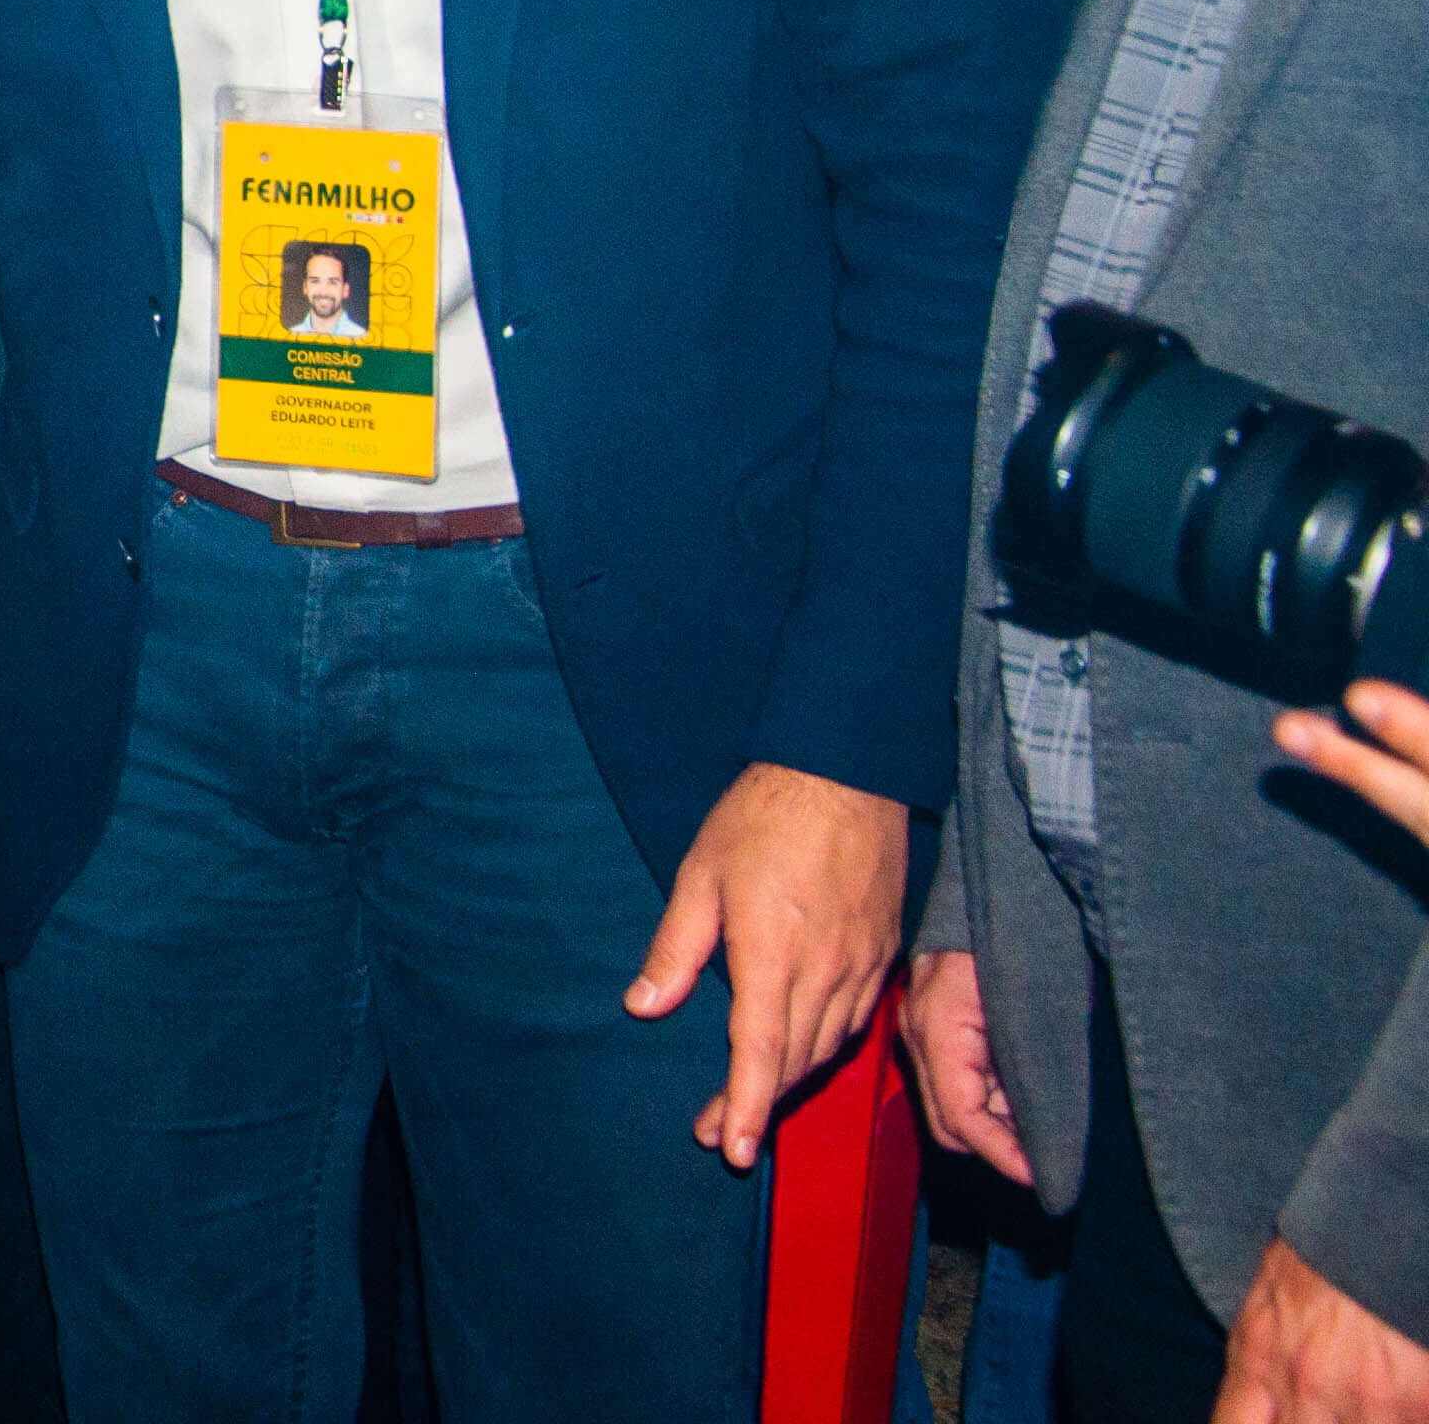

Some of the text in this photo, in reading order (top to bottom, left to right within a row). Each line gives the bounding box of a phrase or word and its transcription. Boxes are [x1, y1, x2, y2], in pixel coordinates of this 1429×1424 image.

[241, 177, 415, 212] FENAMILHO
[287, 349, 362, 368] COMISSÃO
[292, 365, 355, 384] CENTRAL
[275, 394, 372, 414] GOVERNADOR
[270, 410, 376, 431] EDUARDO LEITE
